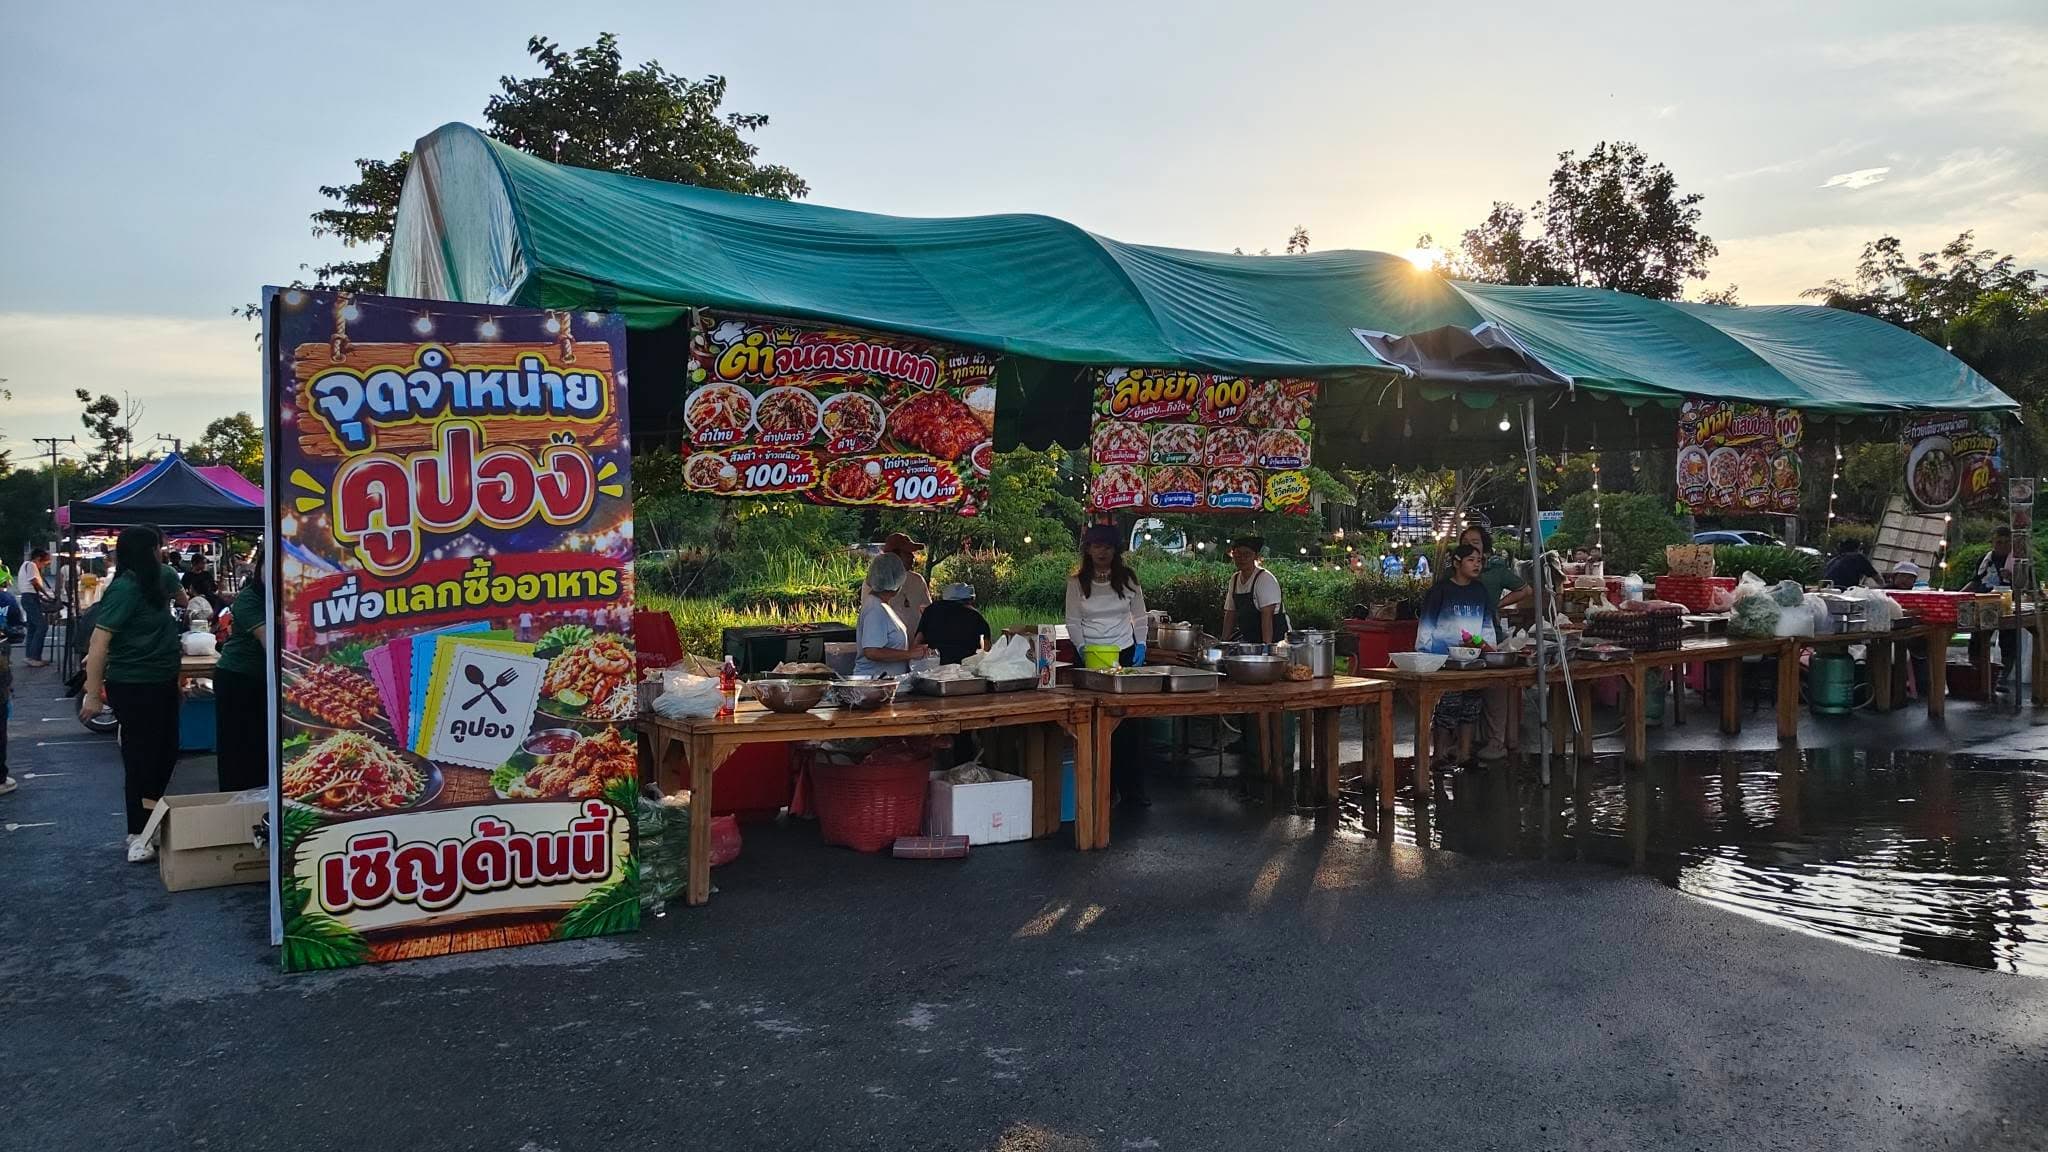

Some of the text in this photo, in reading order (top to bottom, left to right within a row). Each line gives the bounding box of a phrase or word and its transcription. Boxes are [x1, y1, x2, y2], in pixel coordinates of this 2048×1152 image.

[952, 365, 988, 385] ทุกจาน
[315, 347, 598, 443] จุดจำหน่าย
[1204, 379, 1246, 412] 100
[1218, 406, 1237, 419] บาท
[699, 429, 733, 442] ตำไทย
[729, 449, 756, 463] ส้มตำ
[764, 450, 801, 466] ข้าวเหนียว
[883, 456, 910, 470] ไก่ย่าง
[1095, 451, 1100, 462] 1
[1152, 452, 1159, 461] 2
[1207, 455, 1213, 465] 3
[1259, 456, 1266, 465] 4
[744, 462, 809, 489] 100 บาท
[893, 475, 956, 501] 100 บาท
[1096, 494, 1103, 504] 5
[1152, 494, 1159, 504] 6
[1211, 495, 1217, 504] 7
[312, 557, 618, 628] เพื่อแลกซื้ออาหาร
[450, 717, 515, 744] คูปอง
[325, 802, 609, 906] เชิญด้านนี้
